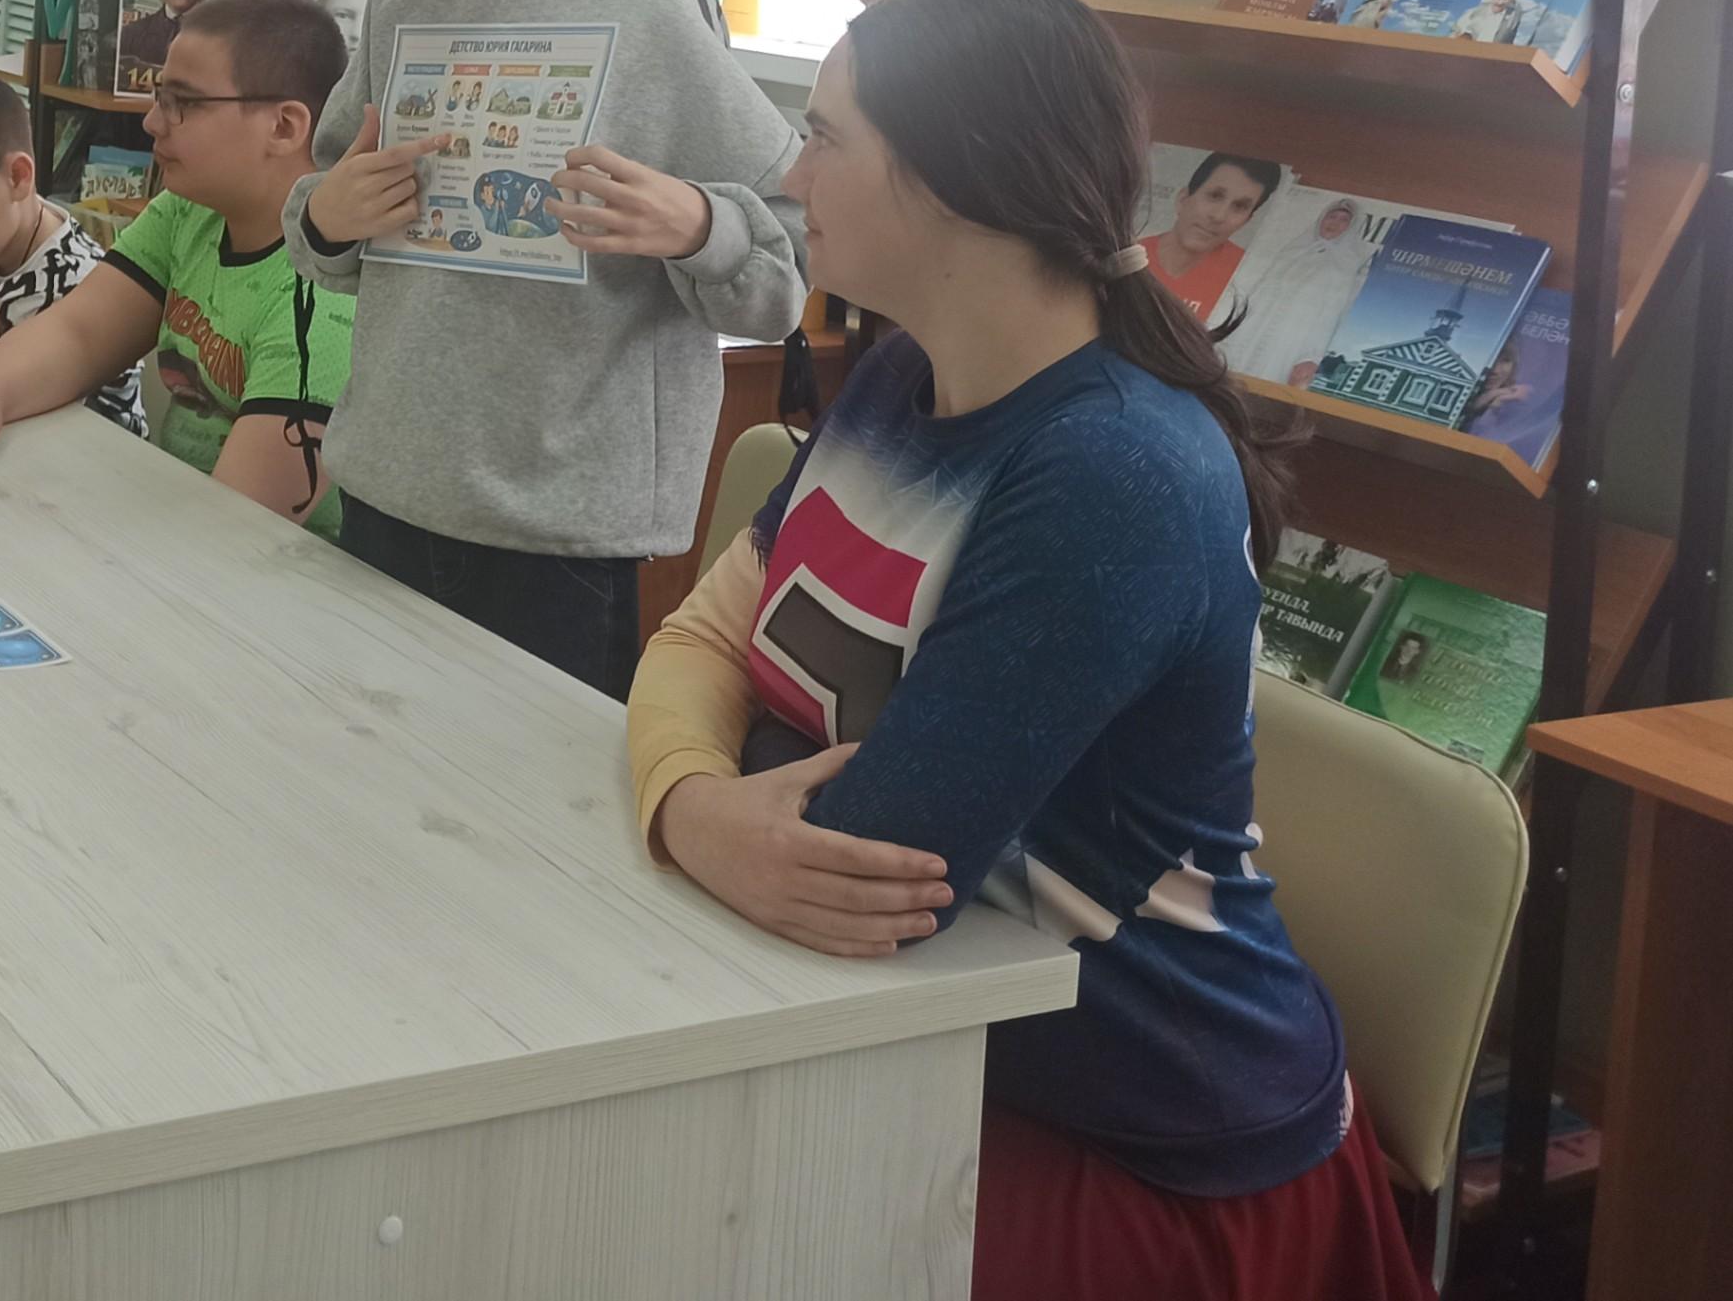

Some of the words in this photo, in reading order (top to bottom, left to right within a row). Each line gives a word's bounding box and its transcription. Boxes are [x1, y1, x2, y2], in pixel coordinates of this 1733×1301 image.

[449, 40, 484, 54] ДЕТСТВО
[485, 40, 509, 53] ЮРИЯ
[510, 40, 553, 53] ГАГАРИНА
